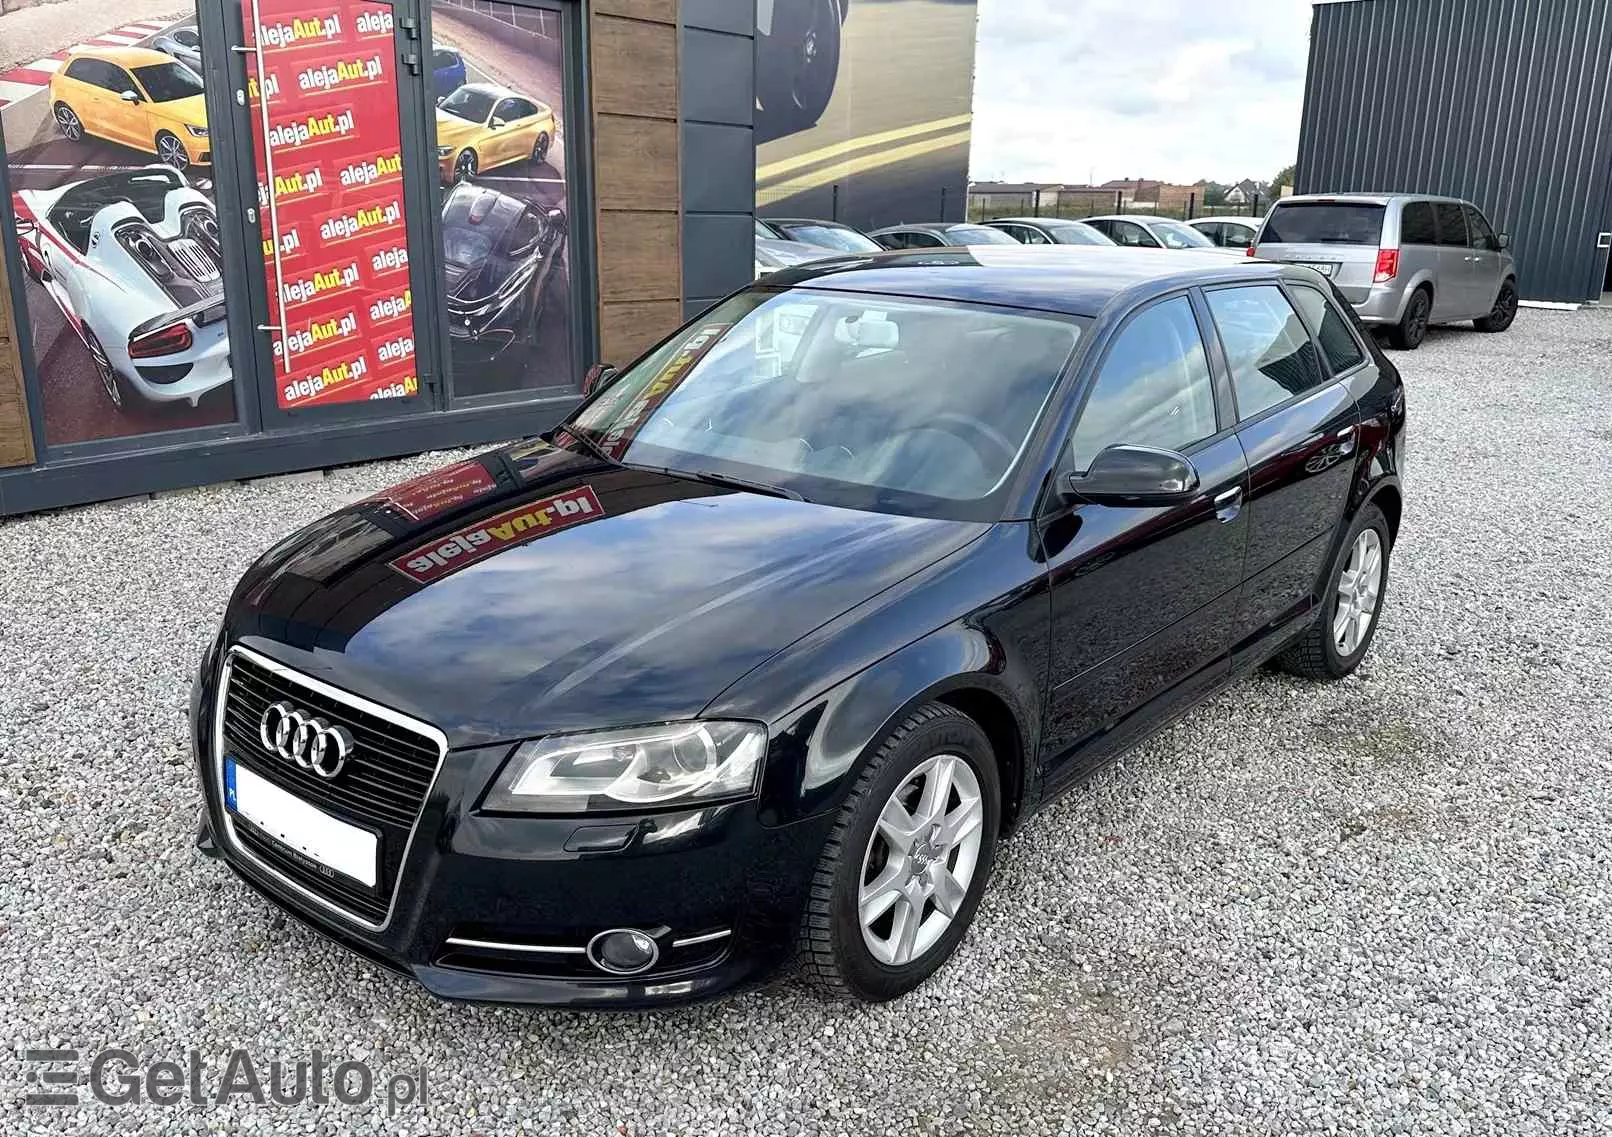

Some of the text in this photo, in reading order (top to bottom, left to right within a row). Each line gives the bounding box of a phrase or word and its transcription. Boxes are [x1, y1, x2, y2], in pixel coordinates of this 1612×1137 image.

[298, 55, 383, 91] alejaAut.pl
[269, 110, 354, 146] alejaAut.pl
[340, 152, 403, 187] alejaAut
[319, 201, 401, 239] alejaAut.pl
[273, 312, 357, 356] aejaAut.pl
[284, 356, 368, 402] alejaAut.pl
